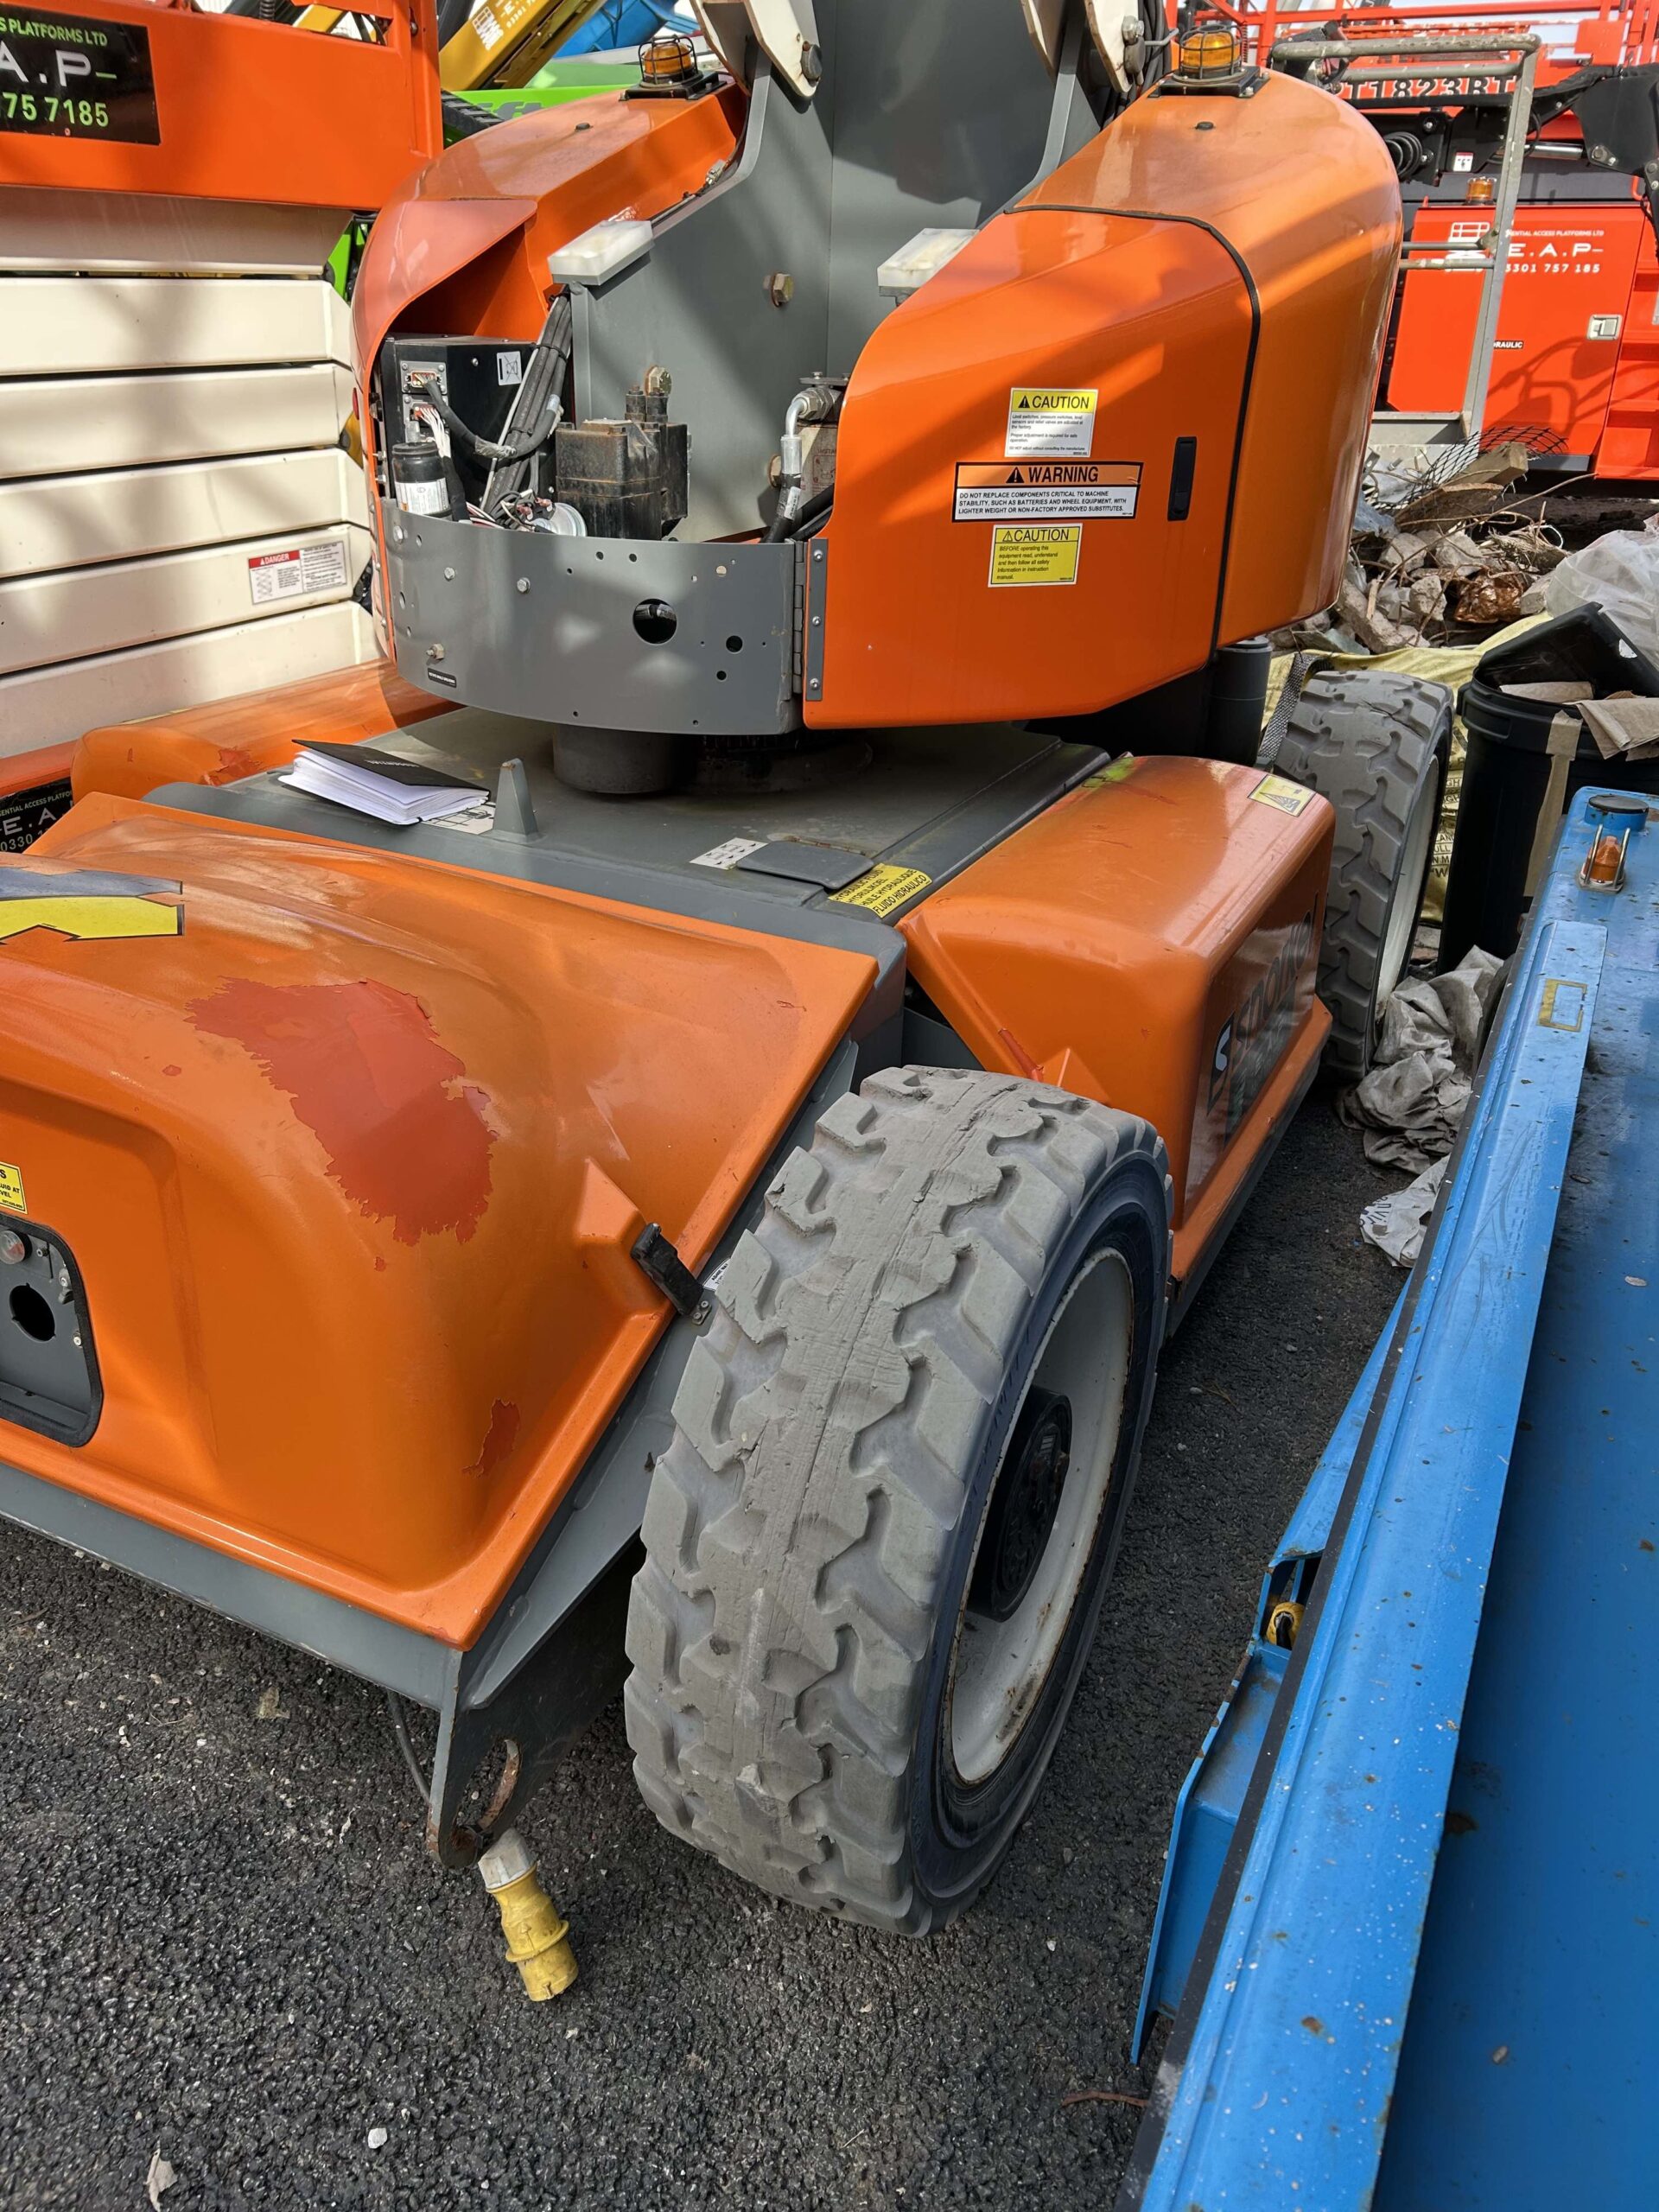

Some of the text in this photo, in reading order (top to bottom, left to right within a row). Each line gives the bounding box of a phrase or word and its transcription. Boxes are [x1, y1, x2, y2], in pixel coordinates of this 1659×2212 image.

[9, 18, 84, 43] PLATFORMS
[86, 30, 108, 47] LTD
[3, 92, 109, 127] 75 7185
[1544, 264, 1570, 273] 757
[1575, 264, 1600, 273] 185
[1033, 396, 1090, 409] CAUTION
[1028, 467, 1098, 483] WARNING
[1014, 529, 1069, 542] CAUTION
[264, 553, 289, 564] DANGER
[24, 798, 48, 810] ACCESS
[873, 894, 896, 914] FLUIDO
